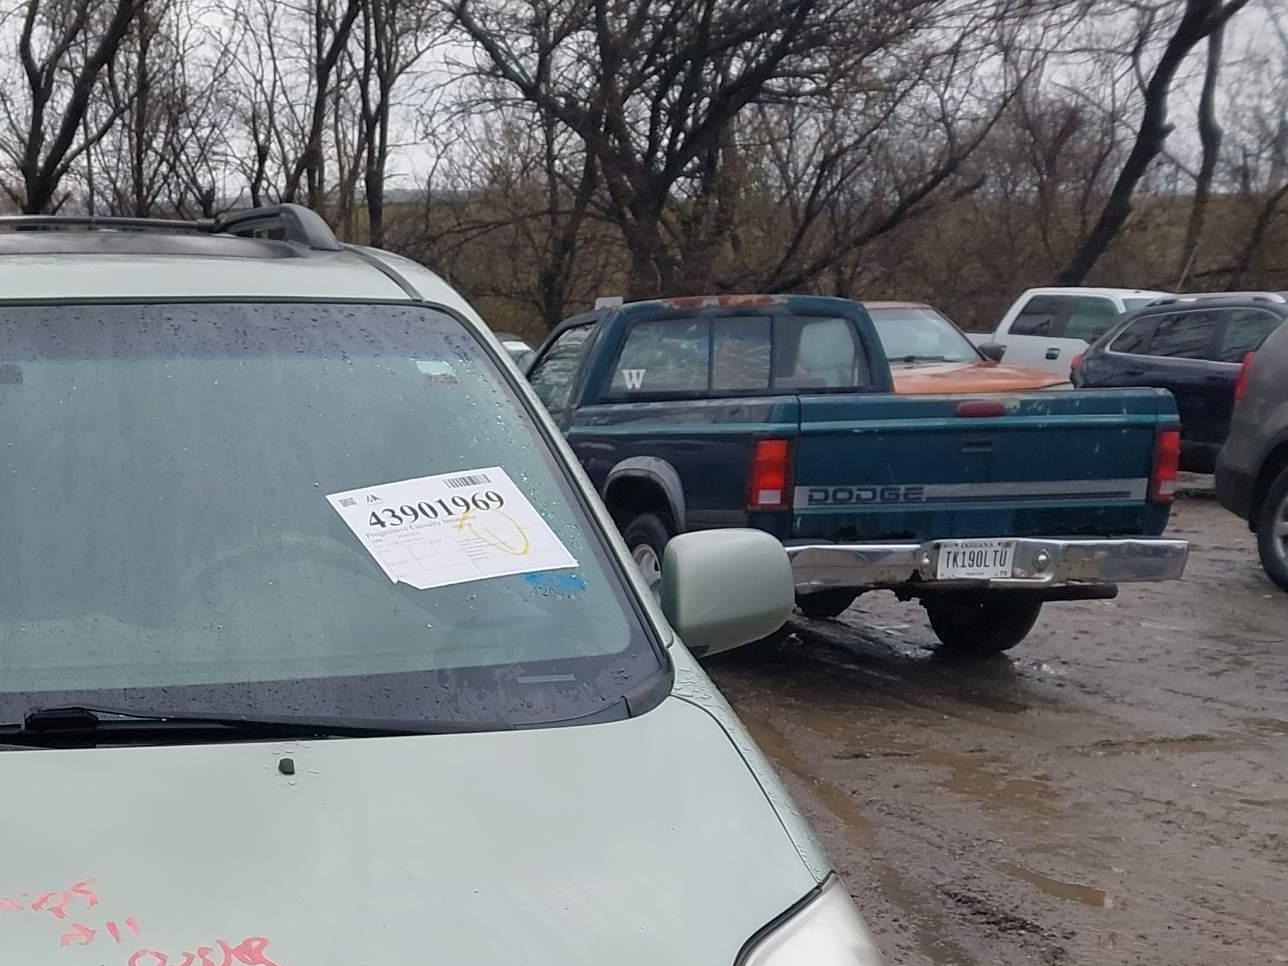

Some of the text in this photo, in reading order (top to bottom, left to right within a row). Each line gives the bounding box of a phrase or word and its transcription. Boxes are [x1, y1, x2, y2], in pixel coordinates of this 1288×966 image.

[621, 368, 647, 390] W
[808, 486, 924, 505] DODGE
[369, 490, 505, 529] 43901969
[944, 549, 1009, 569] TK190LTU
